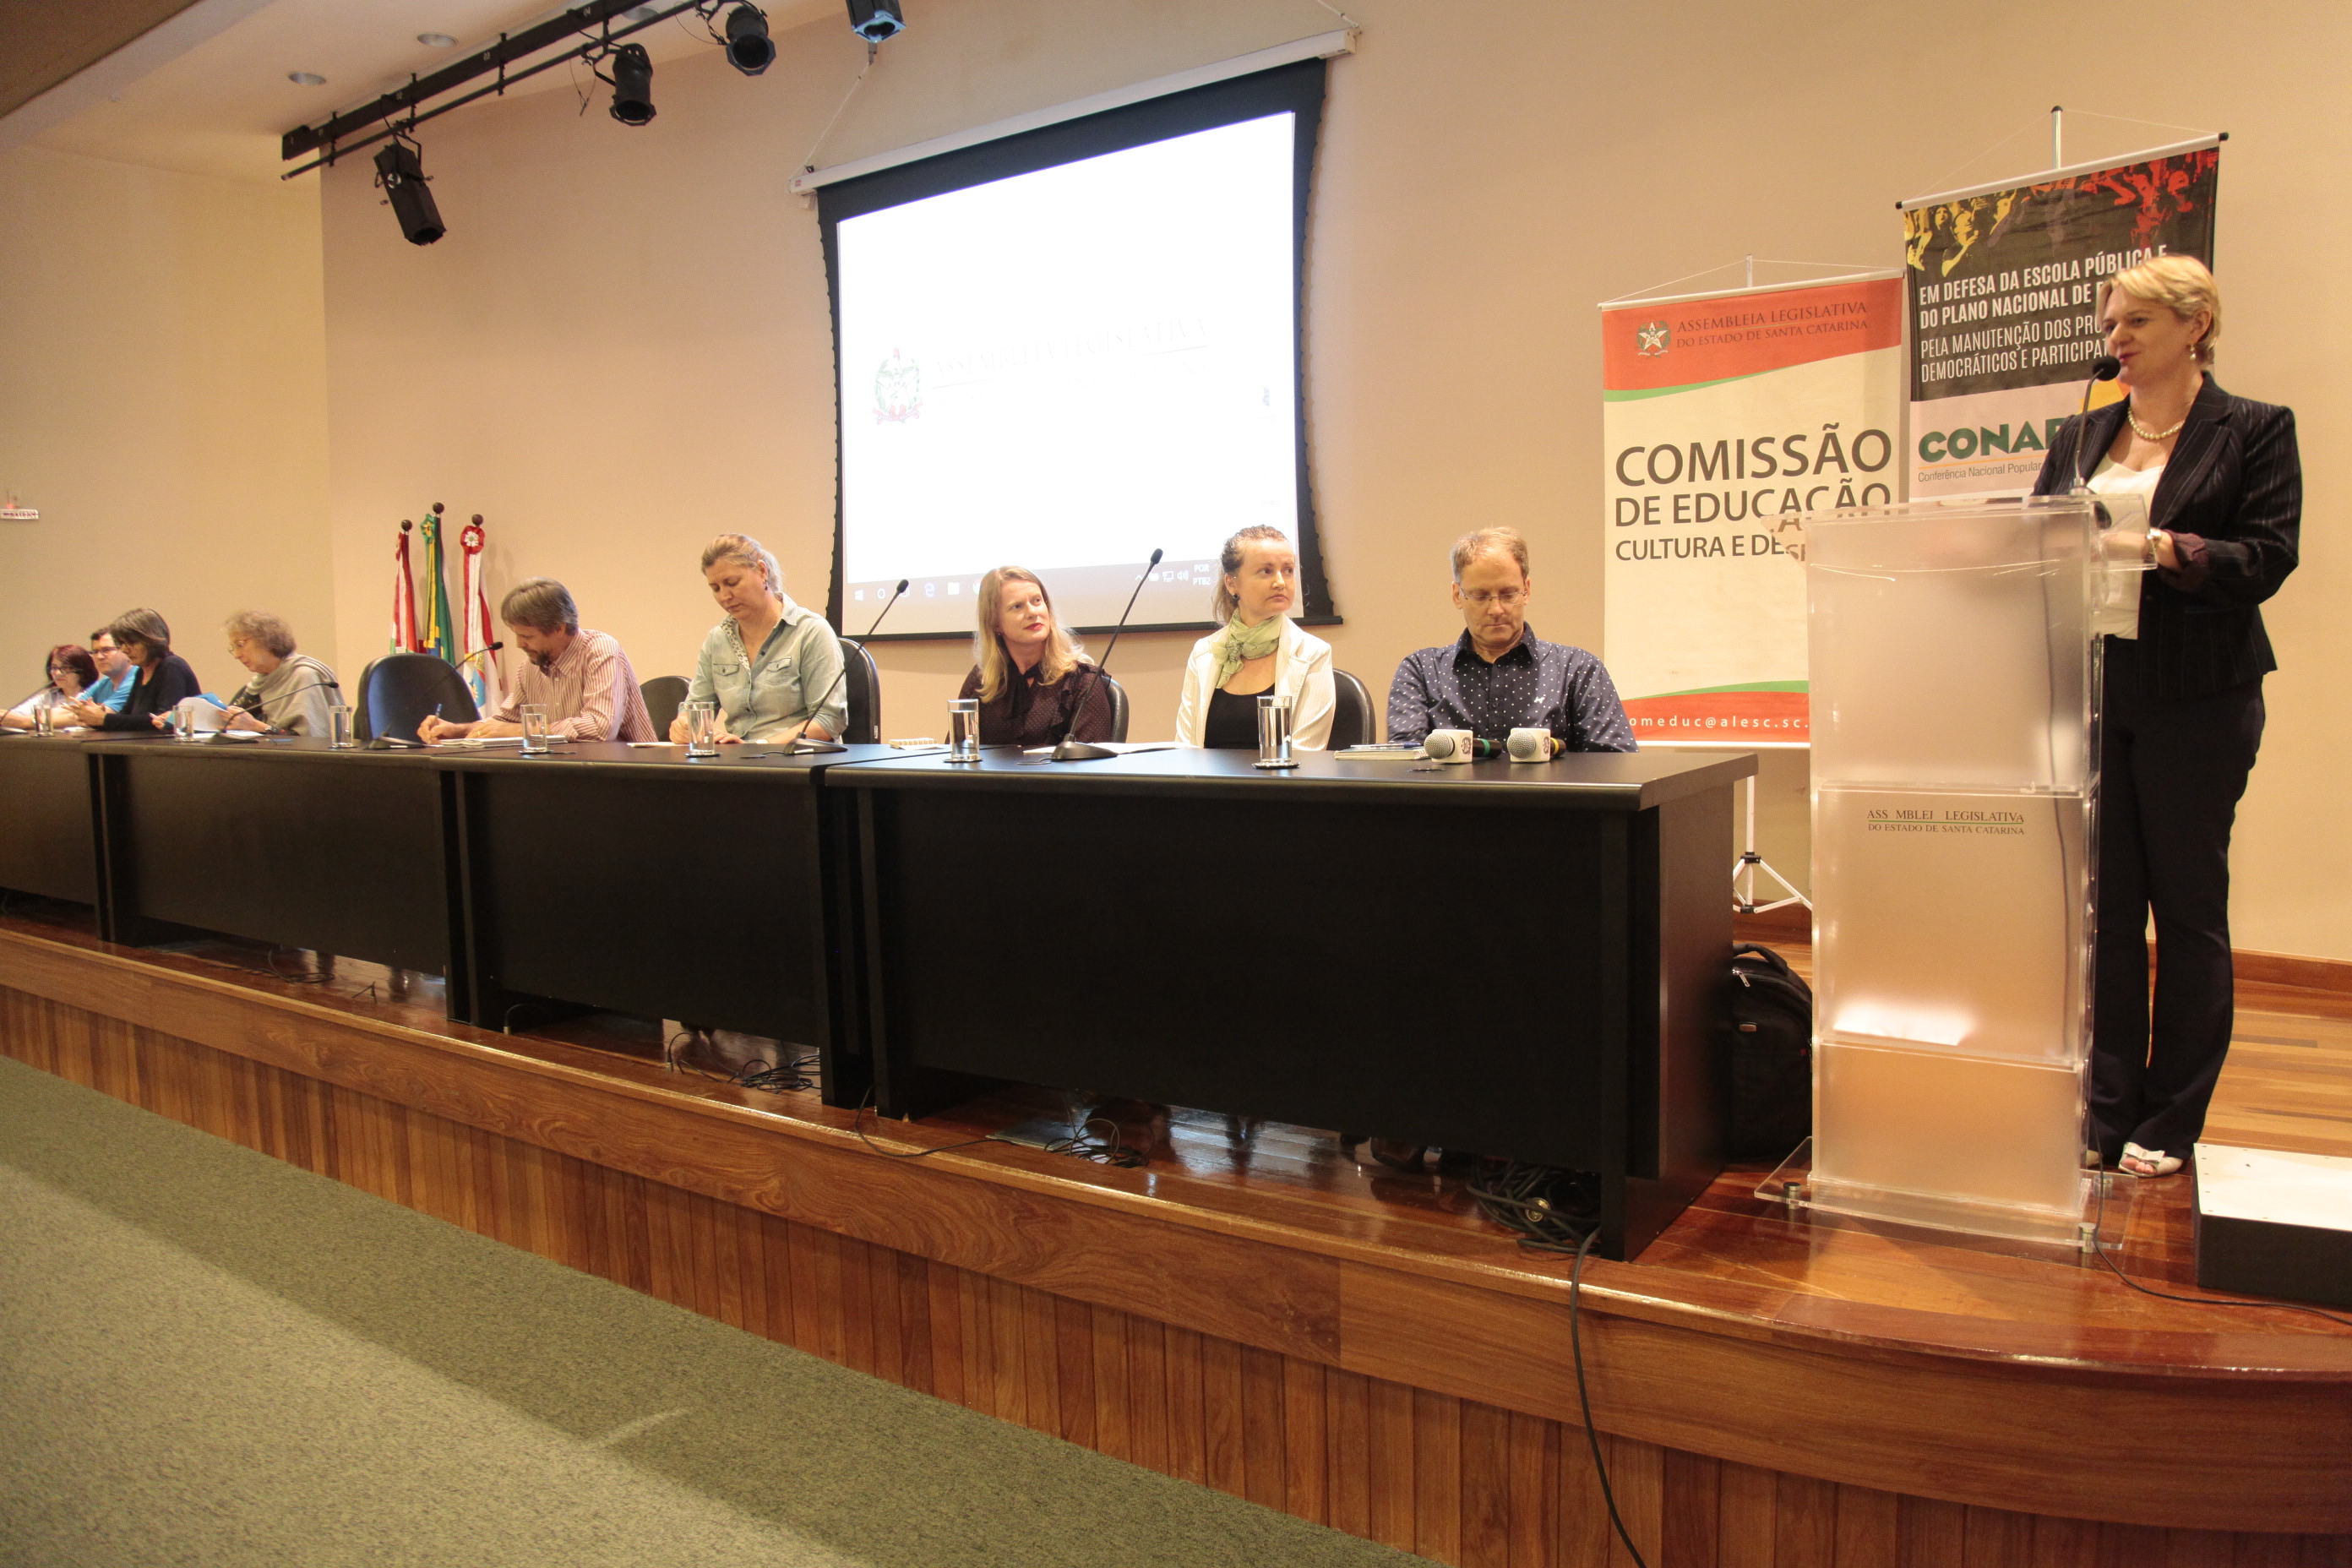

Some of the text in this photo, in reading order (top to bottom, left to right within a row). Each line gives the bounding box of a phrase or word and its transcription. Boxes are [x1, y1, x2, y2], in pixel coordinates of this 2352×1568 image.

[1919, 285, 1939, 305] EM
[1944, 275, 1995, 301] DEFESA
[2000, 270, 2019, 291] DA
[2023, 259, 2080, 288] ESCOLA
[2085, 247, 2153, 277] PÚBLICA
[1677, 302, 1867, 332] ASSEMBLEIA LEGISLATIVA
[1920, 308, 1938, 329] DO
[1942, 300, 1988, 325] PLANO
[1992, 287, 2068, 318] NACIONAL
[2072, 283, 2091, 305] DE
[1676, 320, 1868, 348] DO ESTADO DE SANTA CATARINA
[1921, 337, 1949, 358] PELA
[1952, 321, 2039, 354] MANUTENÇÃO
[2044, 318, 2071, 340] DOS
[1922, 351, 2017, 383] DEMOCRÁTICOS
[2022, 349, 2028, 368] E
[1615, 422, 1892, 487] COMISSÃO
[1919, 461, 2041, 482] Conferência Nacional Popular
[1615, 496, 1661, 527] DE
[1615, 536, 1725, 561] CULTURA
[1733, 535, 1745, 556] E
[1193, 577, 1211, 585] PTB2
[1194, 564, 1210, 573] POR
[1885, 824, 1923, 832] ESTADO
[1942, 825, 1973, 834] SANTA
[1975, 825, 2025, 835] CATARINA
[1945, 810, 2024, 823] LEGISLATIVA
